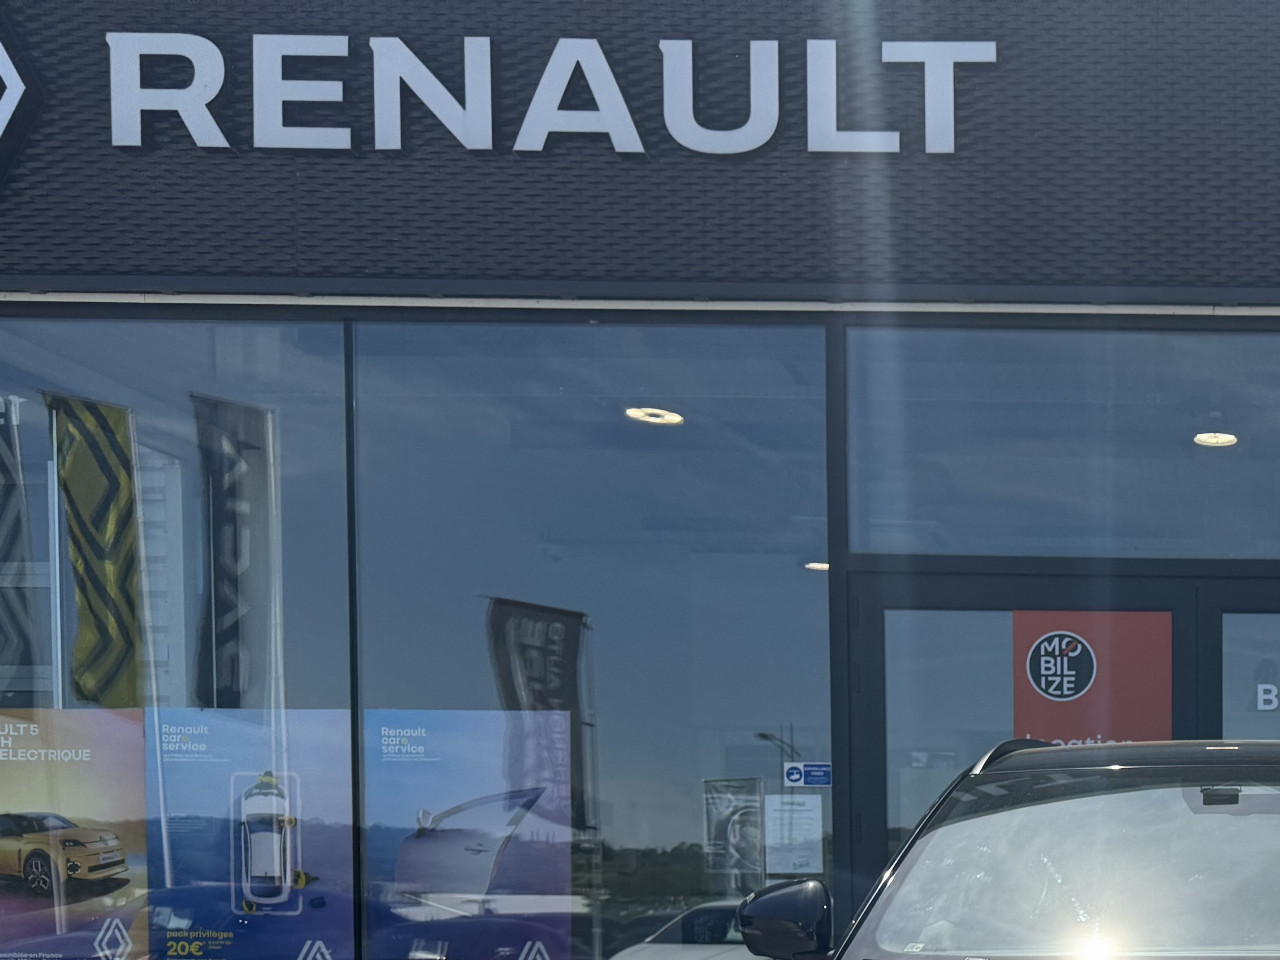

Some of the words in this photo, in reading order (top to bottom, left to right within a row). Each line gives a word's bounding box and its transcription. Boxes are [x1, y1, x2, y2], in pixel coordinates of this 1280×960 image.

[106, 32, 996, 154] RENAULT
[30, 724, 39, 736] 5
[162, 724, 209, 734] Renault
[381, 727, 426, 736] Renault
